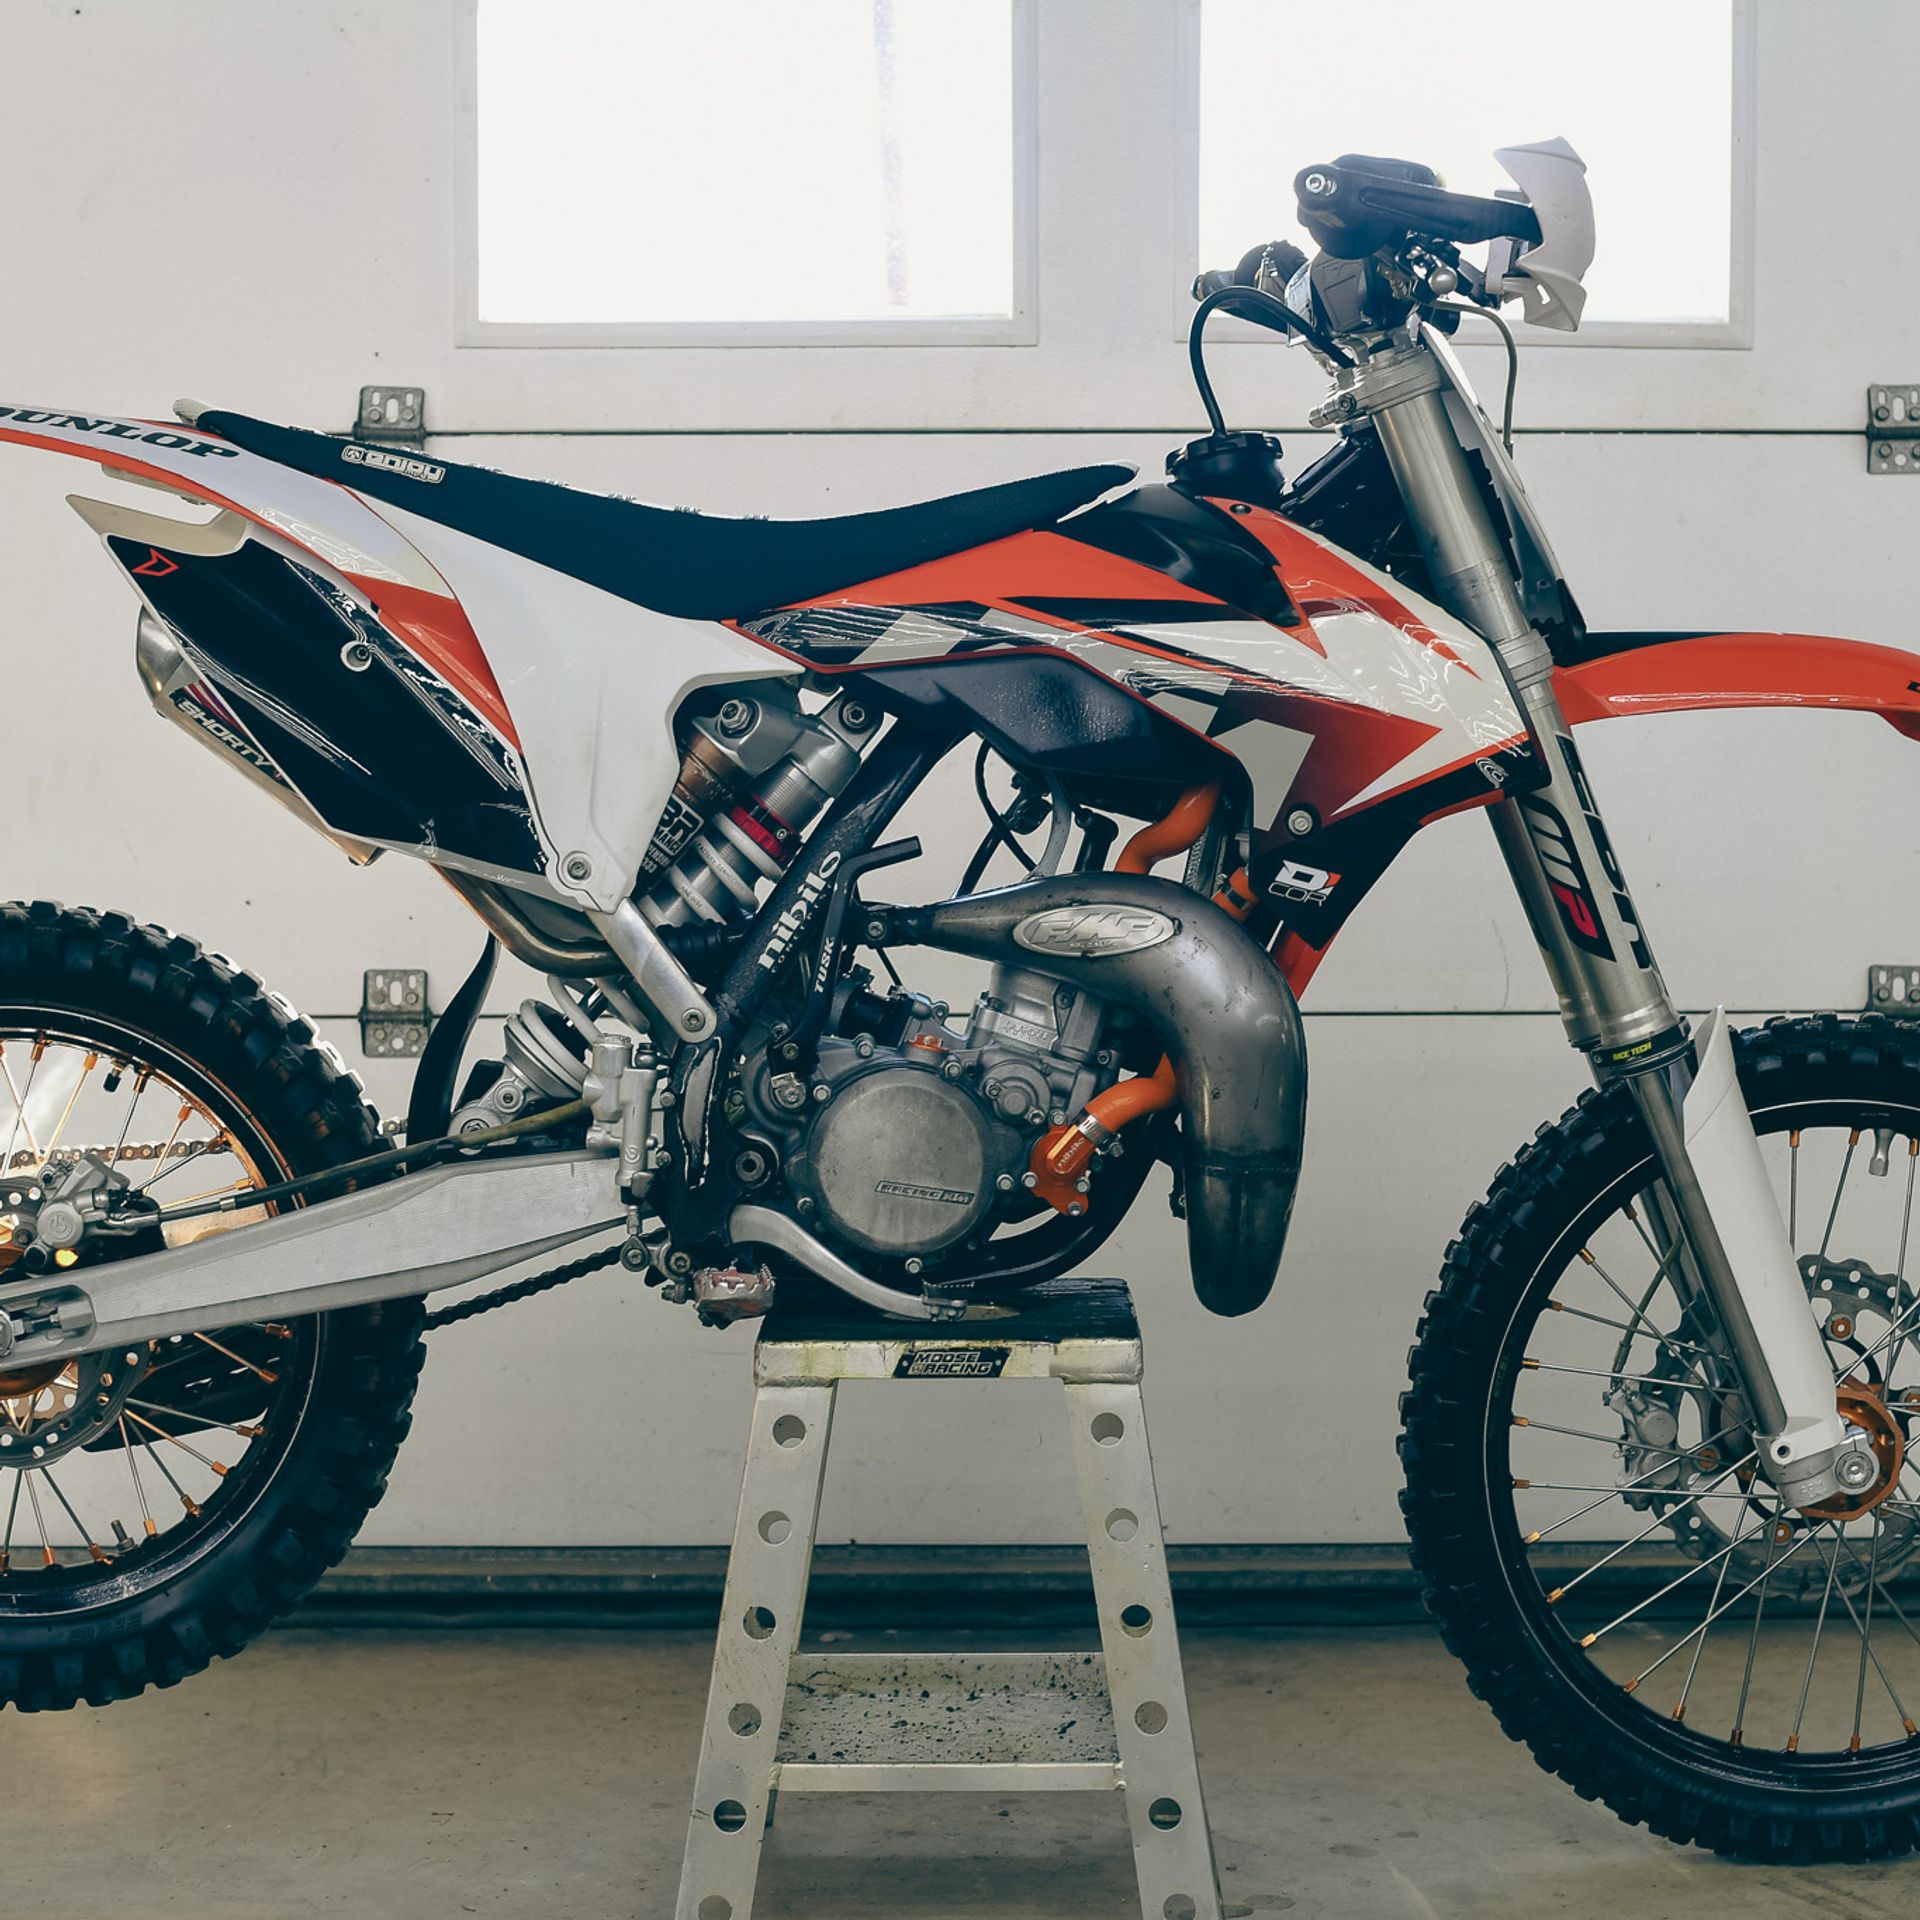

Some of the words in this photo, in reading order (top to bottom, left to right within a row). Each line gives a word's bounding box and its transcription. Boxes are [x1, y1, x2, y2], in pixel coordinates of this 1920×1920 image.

[178, 699, 273, 766] SHORTY
[1029, 911, 1157, 945] FMF
[814, 937, 835, 993] TUSK
[880, 1184, 940, 1200] RACING
[914, 1351, 981, 1363] MOOSE
[921, 1362, 993, 1376] RACING
